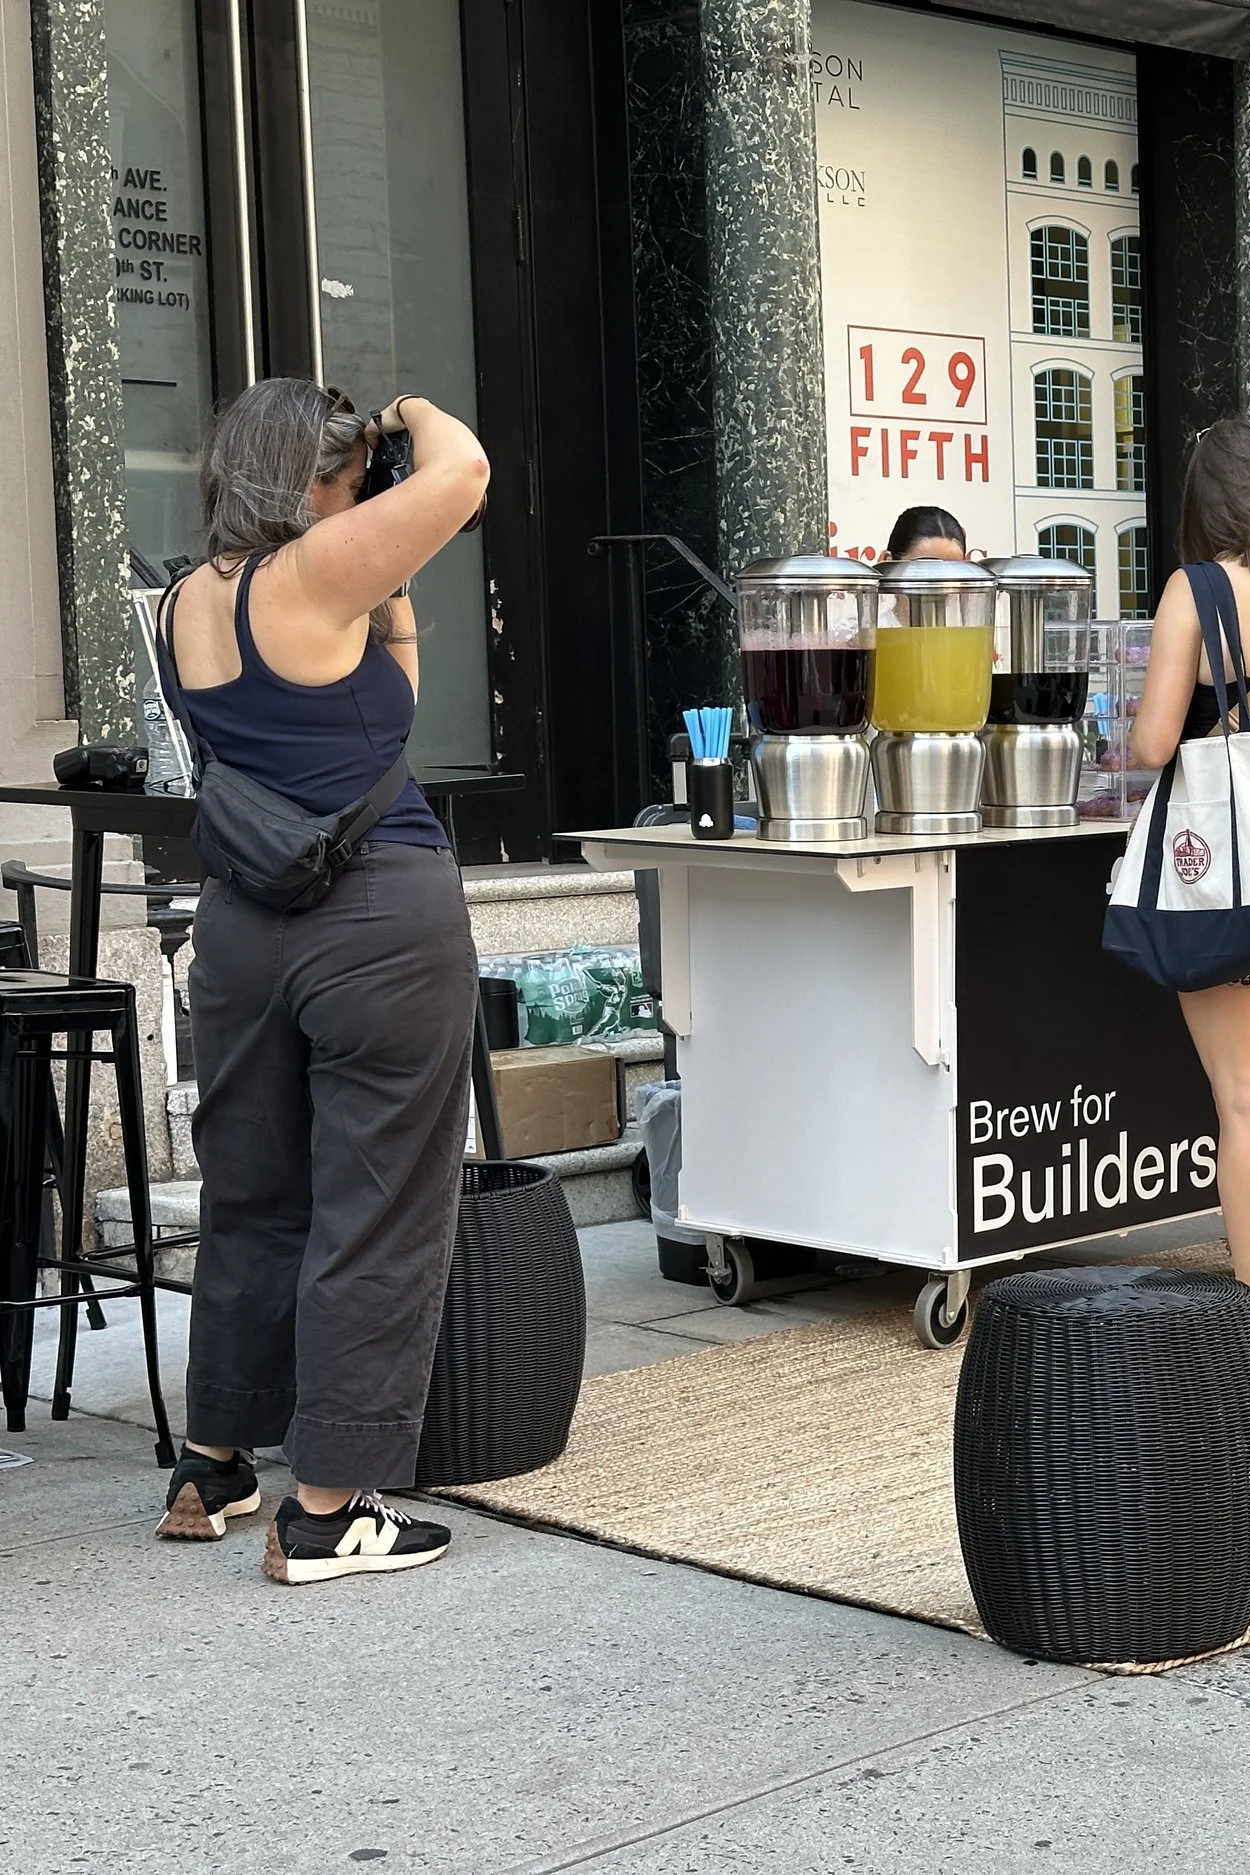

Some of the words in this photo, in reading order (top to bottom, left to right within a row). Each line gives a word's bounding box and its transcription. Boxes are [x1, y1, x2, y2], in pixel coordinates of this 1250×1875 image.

[123, 167, 167, 192] AVE.
[113, 197, 168, 222] ANCE
[118, 227, 203, 257] CORNER
[140, 260, 168, 283] ST.
[158, 291, 190, 311] LOT)
[859, 343, 976, 408] 129
[850, 426, 990, 483] FIFTH
[1175, 857, 1206, 867] TRADER
[969, 1100, 1062, 1145] Brew
[1070, 1084, 1117, 1127] for
[973, 1131, 1217, 1233] Builders
